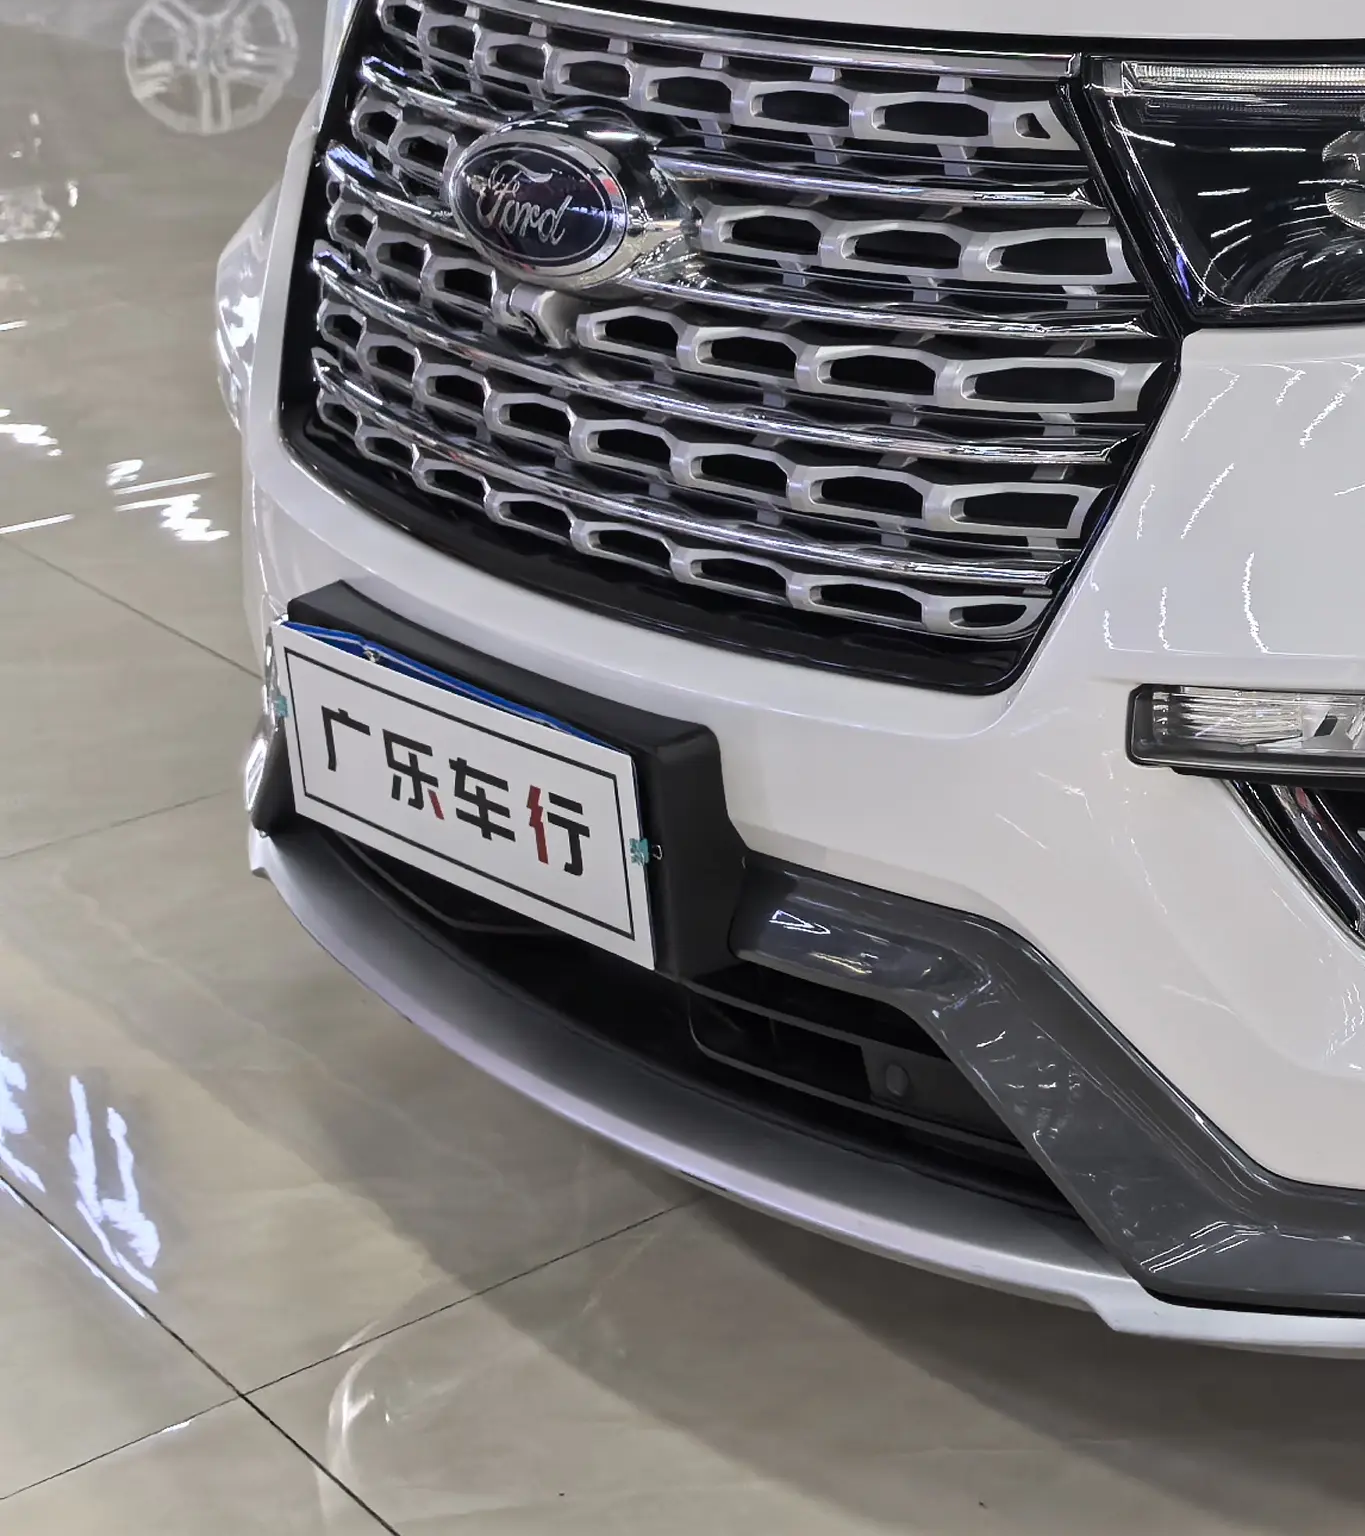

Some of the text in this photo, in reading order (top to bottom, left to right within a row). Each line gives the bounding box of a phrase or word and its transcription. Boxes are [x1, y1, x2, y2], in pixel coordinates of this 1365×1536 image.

[474, 159, 574, 246] Ford
[321, 704, 591, 877] 广乐车行
